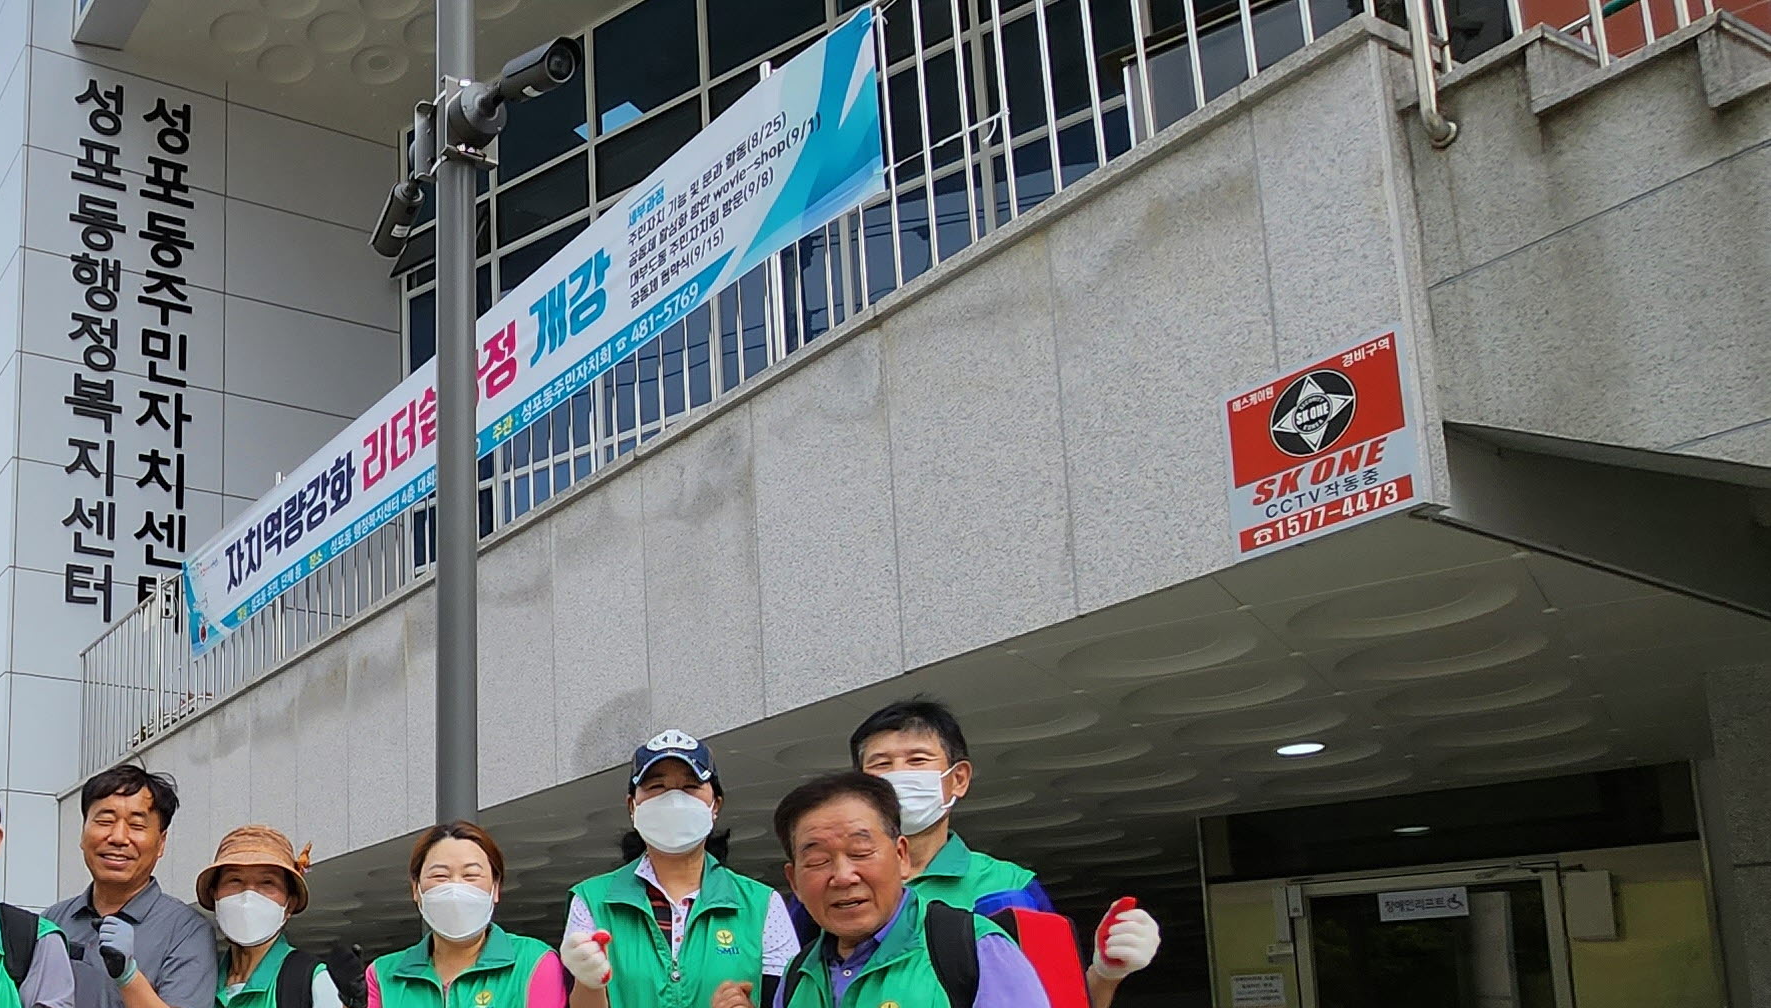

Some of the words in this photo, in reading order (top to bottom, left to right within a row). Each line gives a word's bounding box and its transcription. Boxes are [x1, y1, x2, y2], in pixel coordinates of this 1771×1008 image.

[628, 208, 665, 245] 주민자치
[669, 192, 687, 216] 기능
[690, 182, 699, 196] 및
[629, 235, 657, 268] 공동체
[659, 211, 688, 250] 활성화
[630, 254, 667, 289] 대부도동
[669, 210, 720, 256] 주민자치회
[630, 274, 658, 310] 공동체
[62, 78, 127, 623] 성포동행정복지센터
[1342, 337, 1391, 367] 경비구역
[224, 449, 357, 594] 자치역량강화
[529, 246, 612, 369] 개강
[491, 416, 513, 441] 주관
[520, 342, 612, 423] 성포동주민자치회
[1252, 467, 1306, 507] SK
[1310, 437, 1388, 486] ONE
[1275, 482, 1398, 541] 1577-4473
